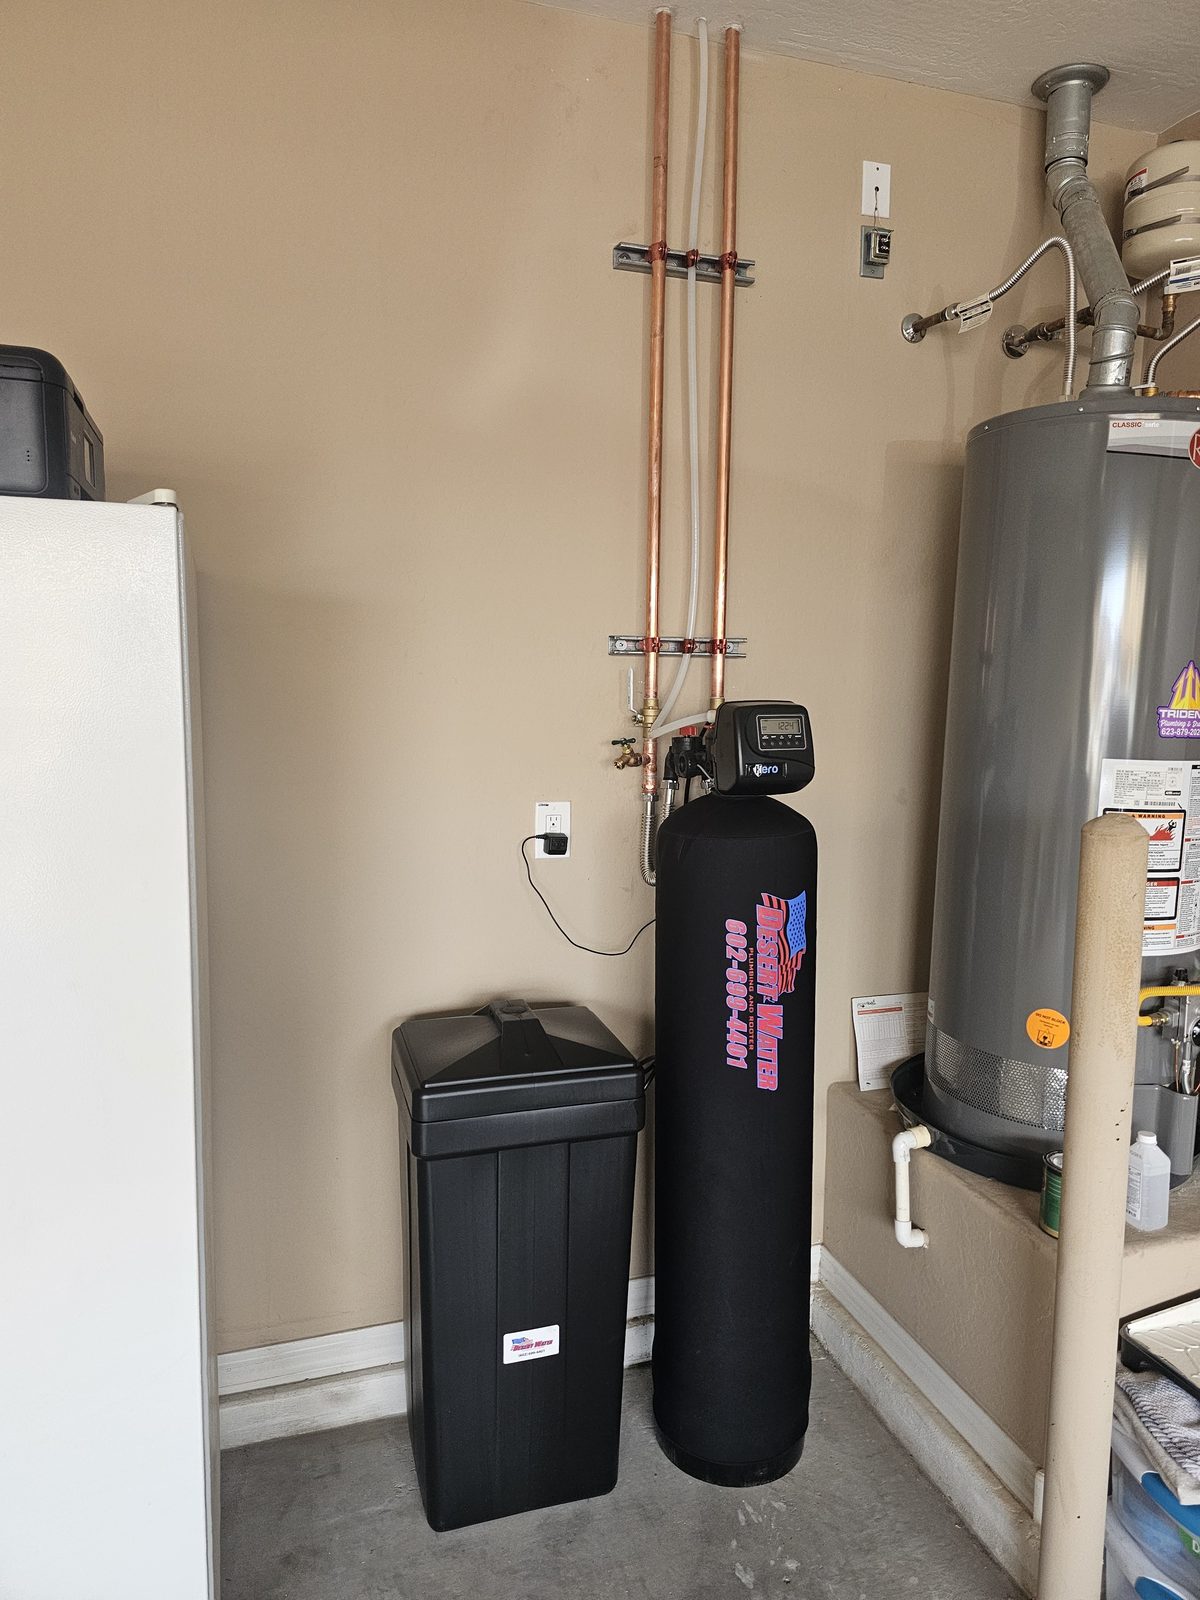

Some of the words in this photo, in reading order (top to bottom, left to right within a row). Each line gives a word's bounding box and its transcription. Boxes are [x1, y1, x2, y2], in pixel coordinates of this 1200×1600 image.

[1159, 709, 1200, 719] TRIDEN
[1160, 719, 1187, 728] Plumbing
[1161, 727, 1200, 736] 623-879-202
[756, 904, 784, 1002] DESERT
[725, 919, 748, 1069] 602-699-4401
[756, 1003, 784, 1091] WATER
[512, 1343, 534, 1351] DESERT
[534, 1339, 554, 1348] WATER
